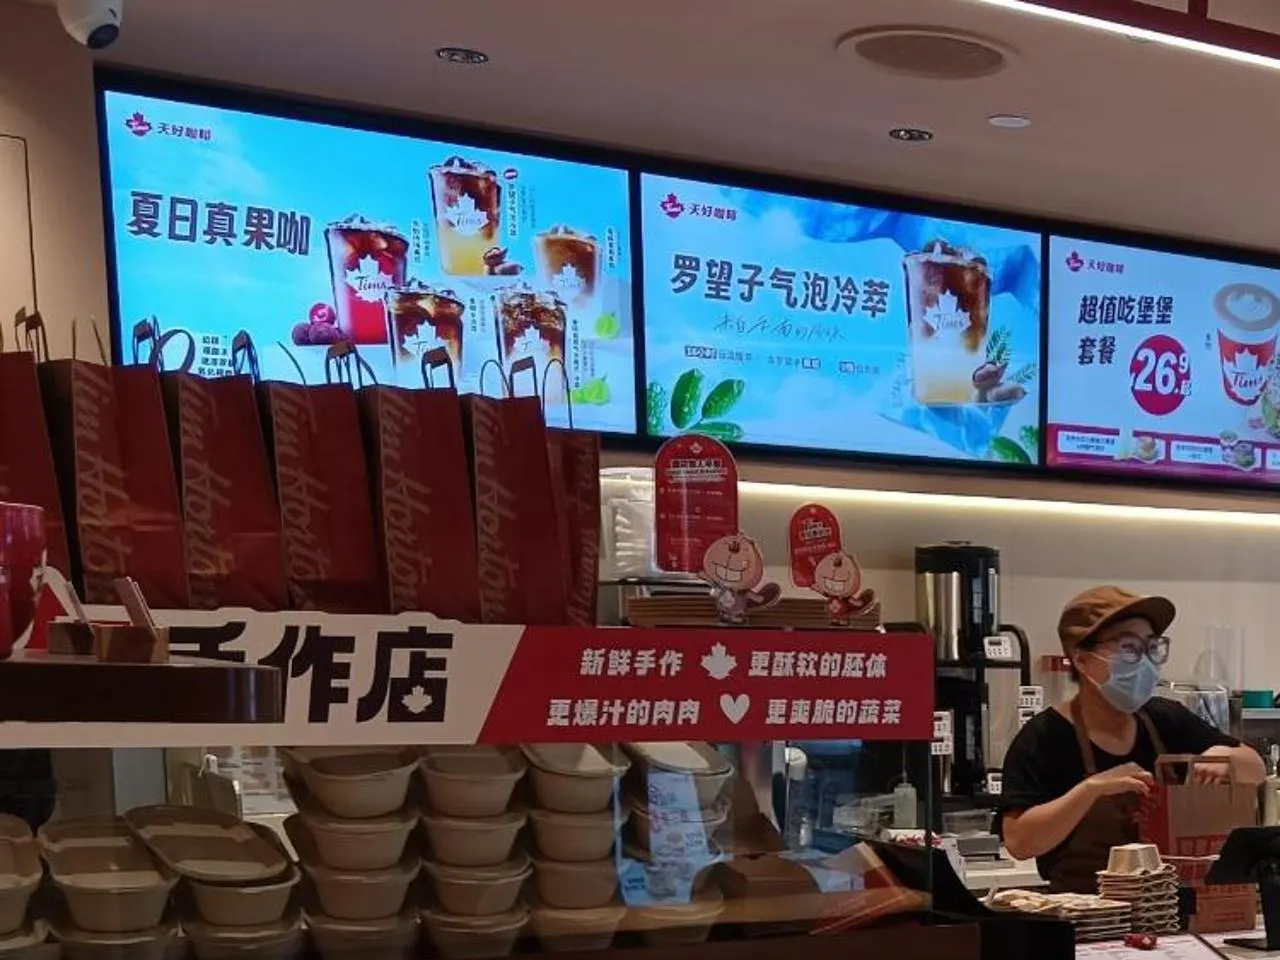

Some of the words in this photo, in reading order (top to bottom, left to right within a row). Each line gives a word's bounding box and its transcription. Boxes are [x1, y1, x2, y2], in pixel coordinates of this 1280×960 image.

[126, 190, 312, 257] 夏日真果咖
[670, 253, 892, 319] 罗望子气泡冷萃
[1078, 294, 1174, 325] 超值吃堡堡
[1078, 335, 1117, 366] 套餐
[579, 648, 684, 676] 新鲜手作
[748, 651, 888, 679] 更酥软的胚体
[547, 699, 702, 726] 更爆汁的肉肉
[765, 699, 902, 725] 更爽脆的蔬菜
